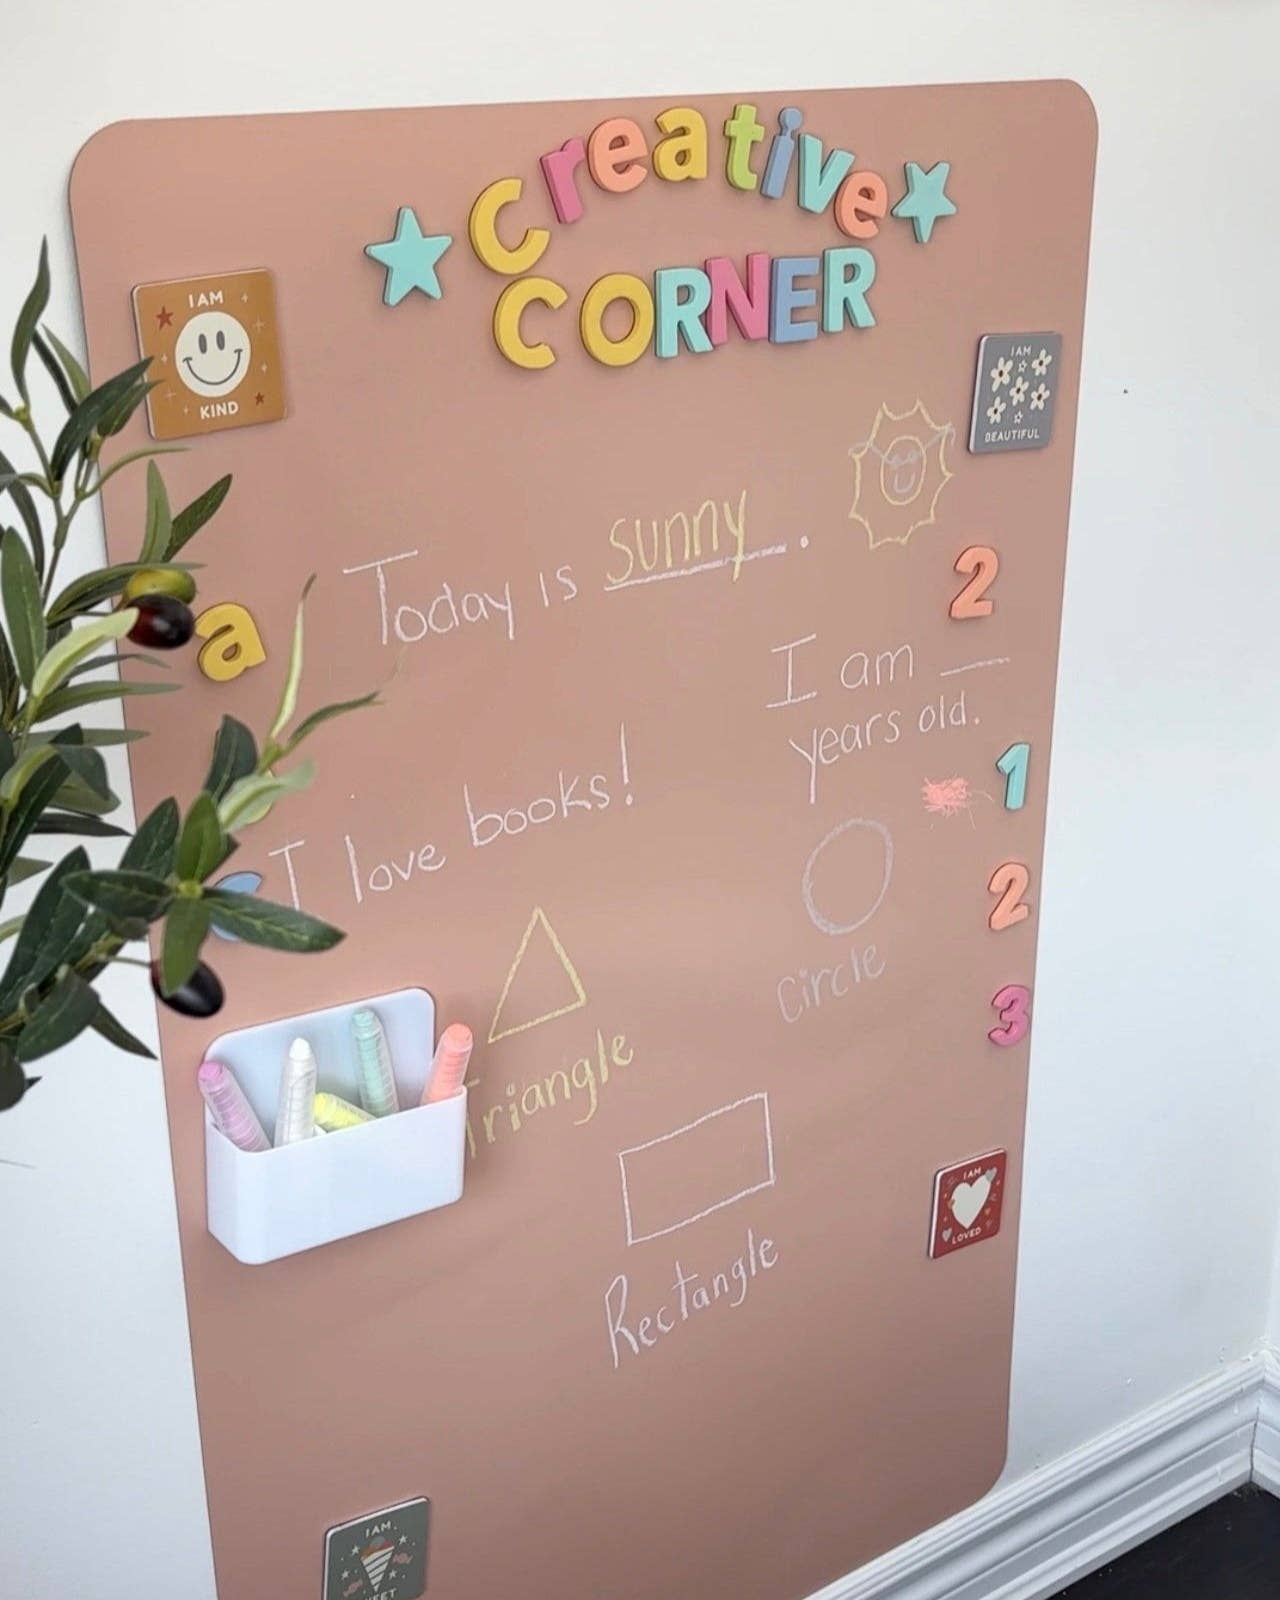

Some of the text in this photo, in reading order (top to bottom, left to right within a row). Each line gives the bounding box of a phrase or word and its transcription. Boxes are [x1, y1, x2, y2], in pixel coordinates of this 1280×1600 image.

[188, 290, 224, 308] I AM
[492, 246, 877, 370] CORNER
[1015, 345, 1032, 357] AM
[200, 401, 239, 420] KIND
[984, 428, 1040, 443] BEAUTIFUL
[343, 550, 516, 645] Today
[949, 544, 998, 621] 2
[195, 602, 267, 682] a
[766, 633, 915, 708] I am
[788, 691, 981, 804] years old.
[996, 742, 1032, 811] 1
[345, 834, 446, 904] love
[463, 721, 634, 847] books!
[987, 862, 1031, 932] 2
[987, 984, 1032, 1048] 3
[967, 1166, 982, 1179] AM
[951, 1227, 982, 1245] LOVED
[604, 1228, 780, 1369] Rectangle
[371, 1520, 392, 1536] AM
